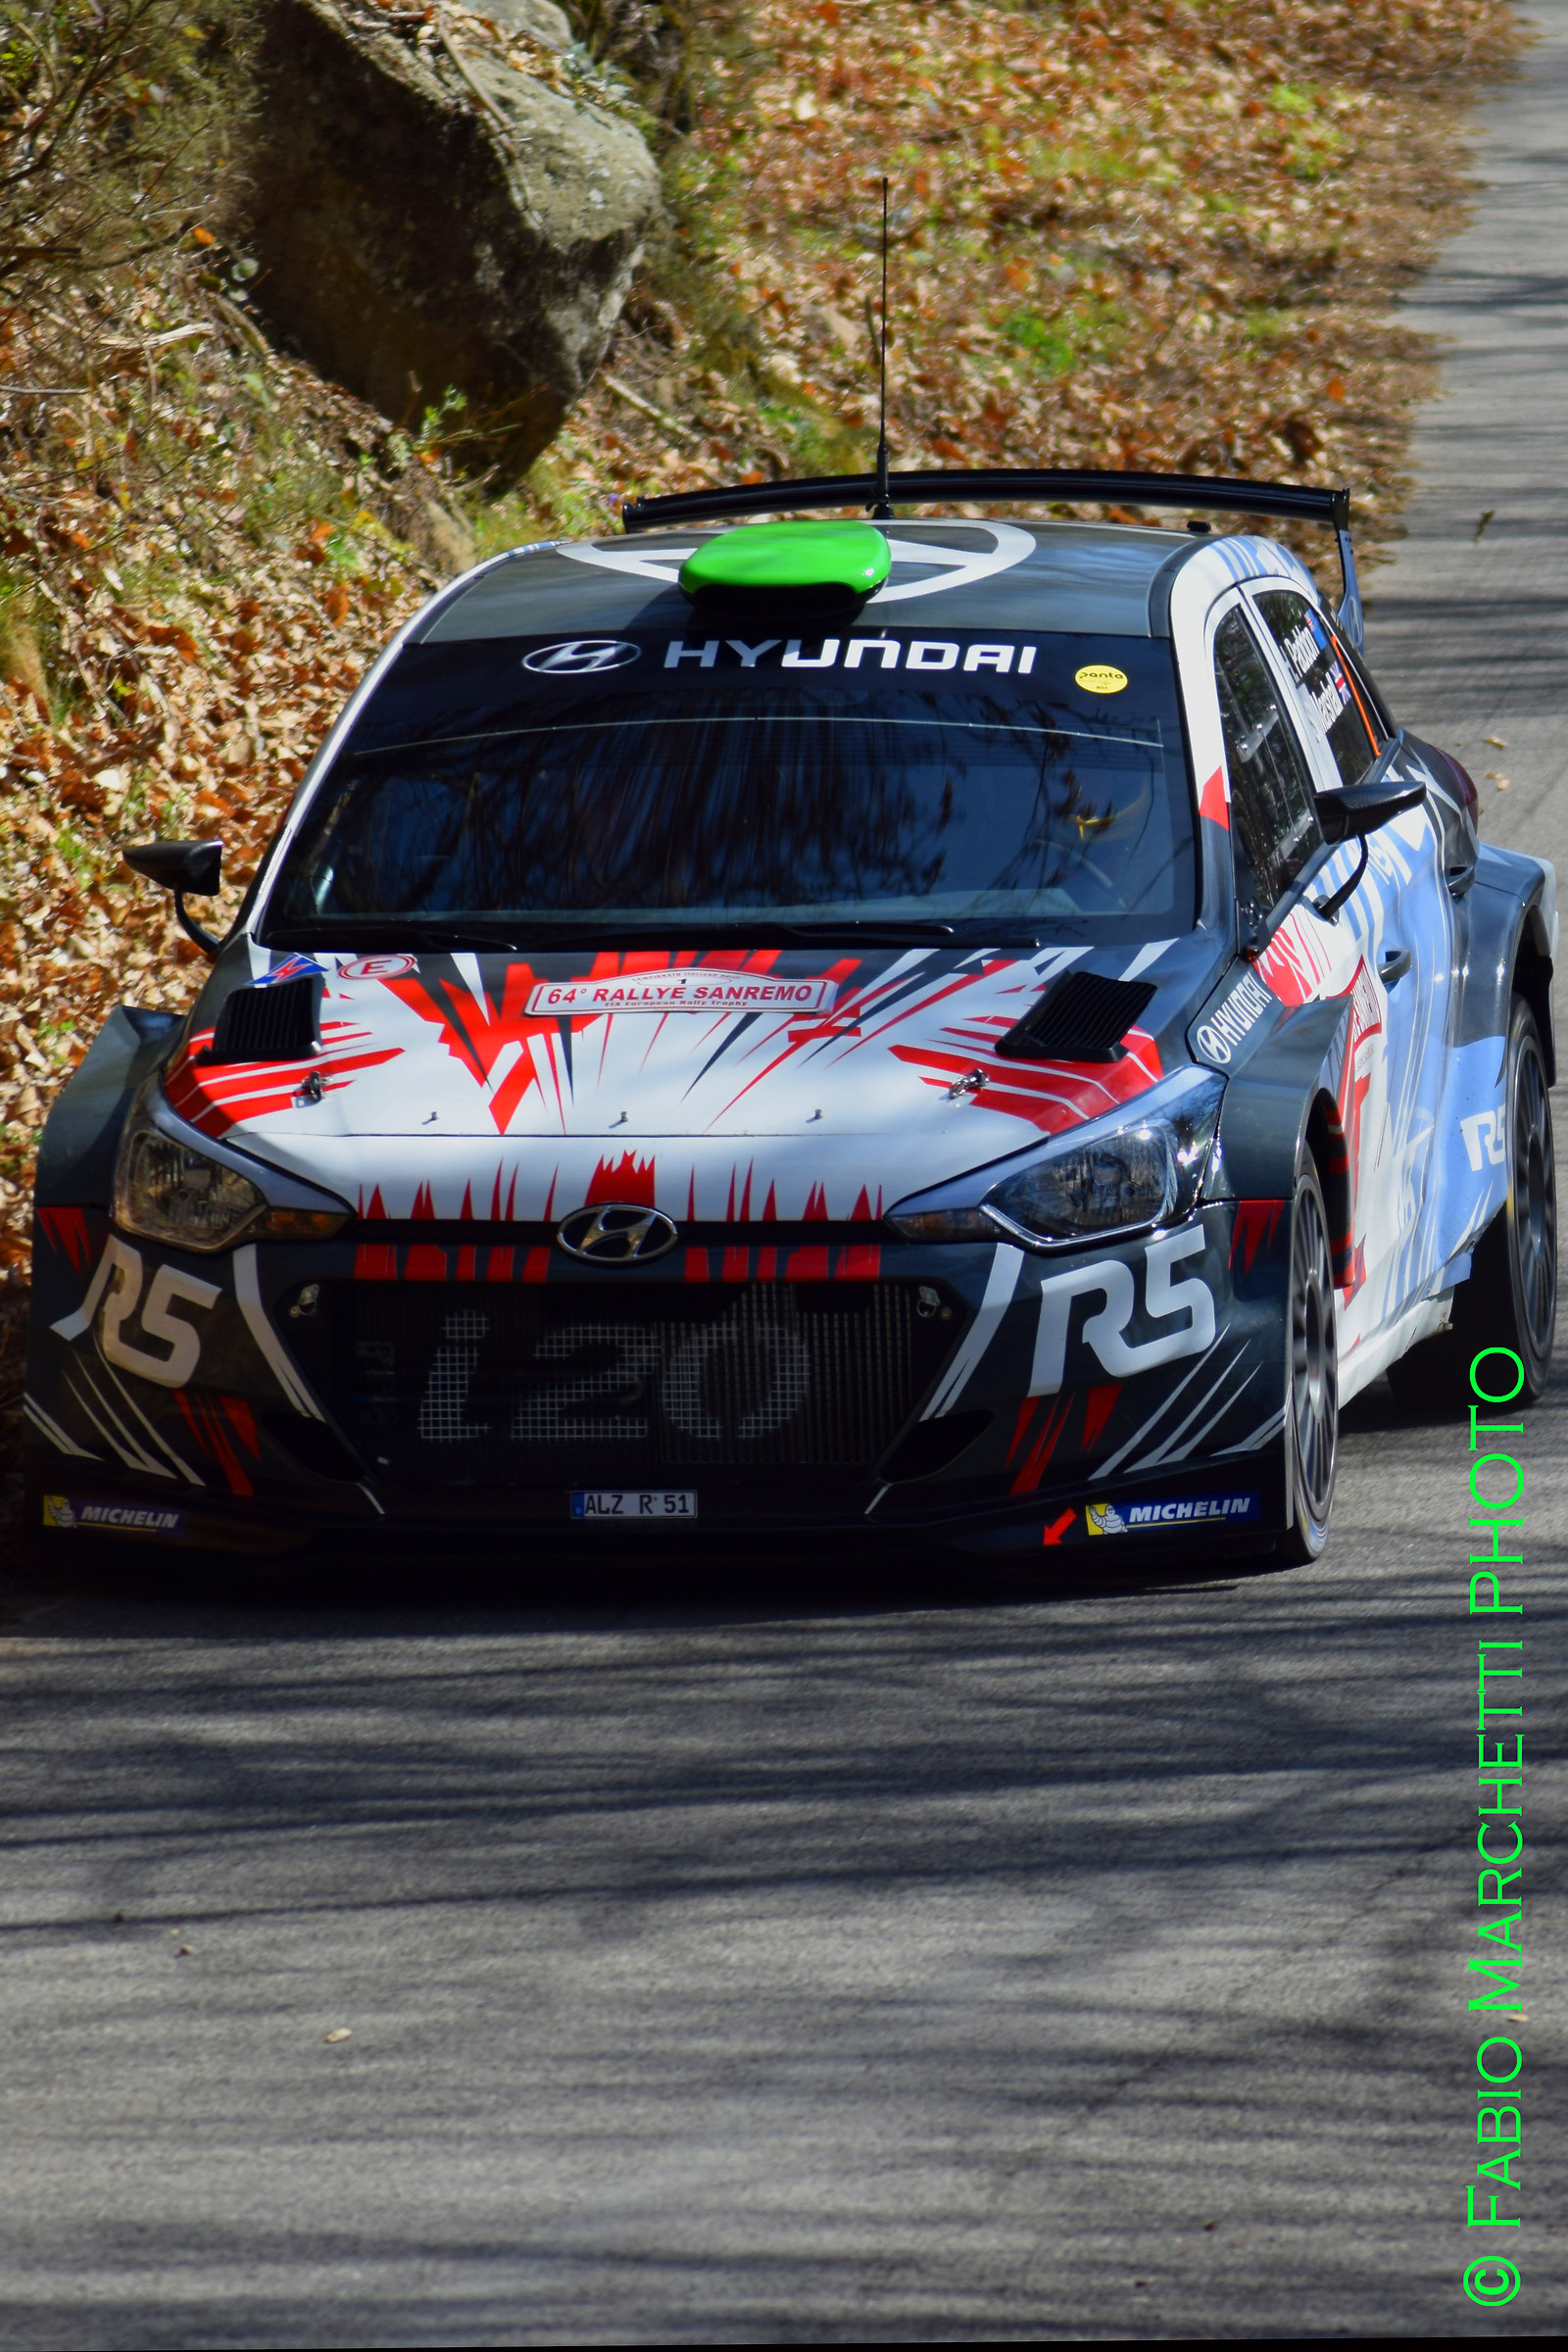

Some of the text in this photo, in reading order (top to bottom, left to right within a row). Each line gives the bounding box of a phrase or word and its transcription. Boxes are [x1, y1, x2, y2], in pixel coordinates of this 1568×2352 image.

[662, 638, 1038, 675] HYUNDAI
[360, 959, 393, 975] E
[592, 986, 687, 1003] RALLYE
[692, 984, 813, 1002] SANREMO
[1210, 971, 1273, 1046] HYUNDAI
[49, 1234, 224, 1389] R5
[1027, 1224, 1216, 1397] R5
[80, 1506, 179, 1529] MICHELIN
[585, 1494, 689, 1515] ALZ R 51
[1128, 1496, 1251, 1523] MICHELIN
